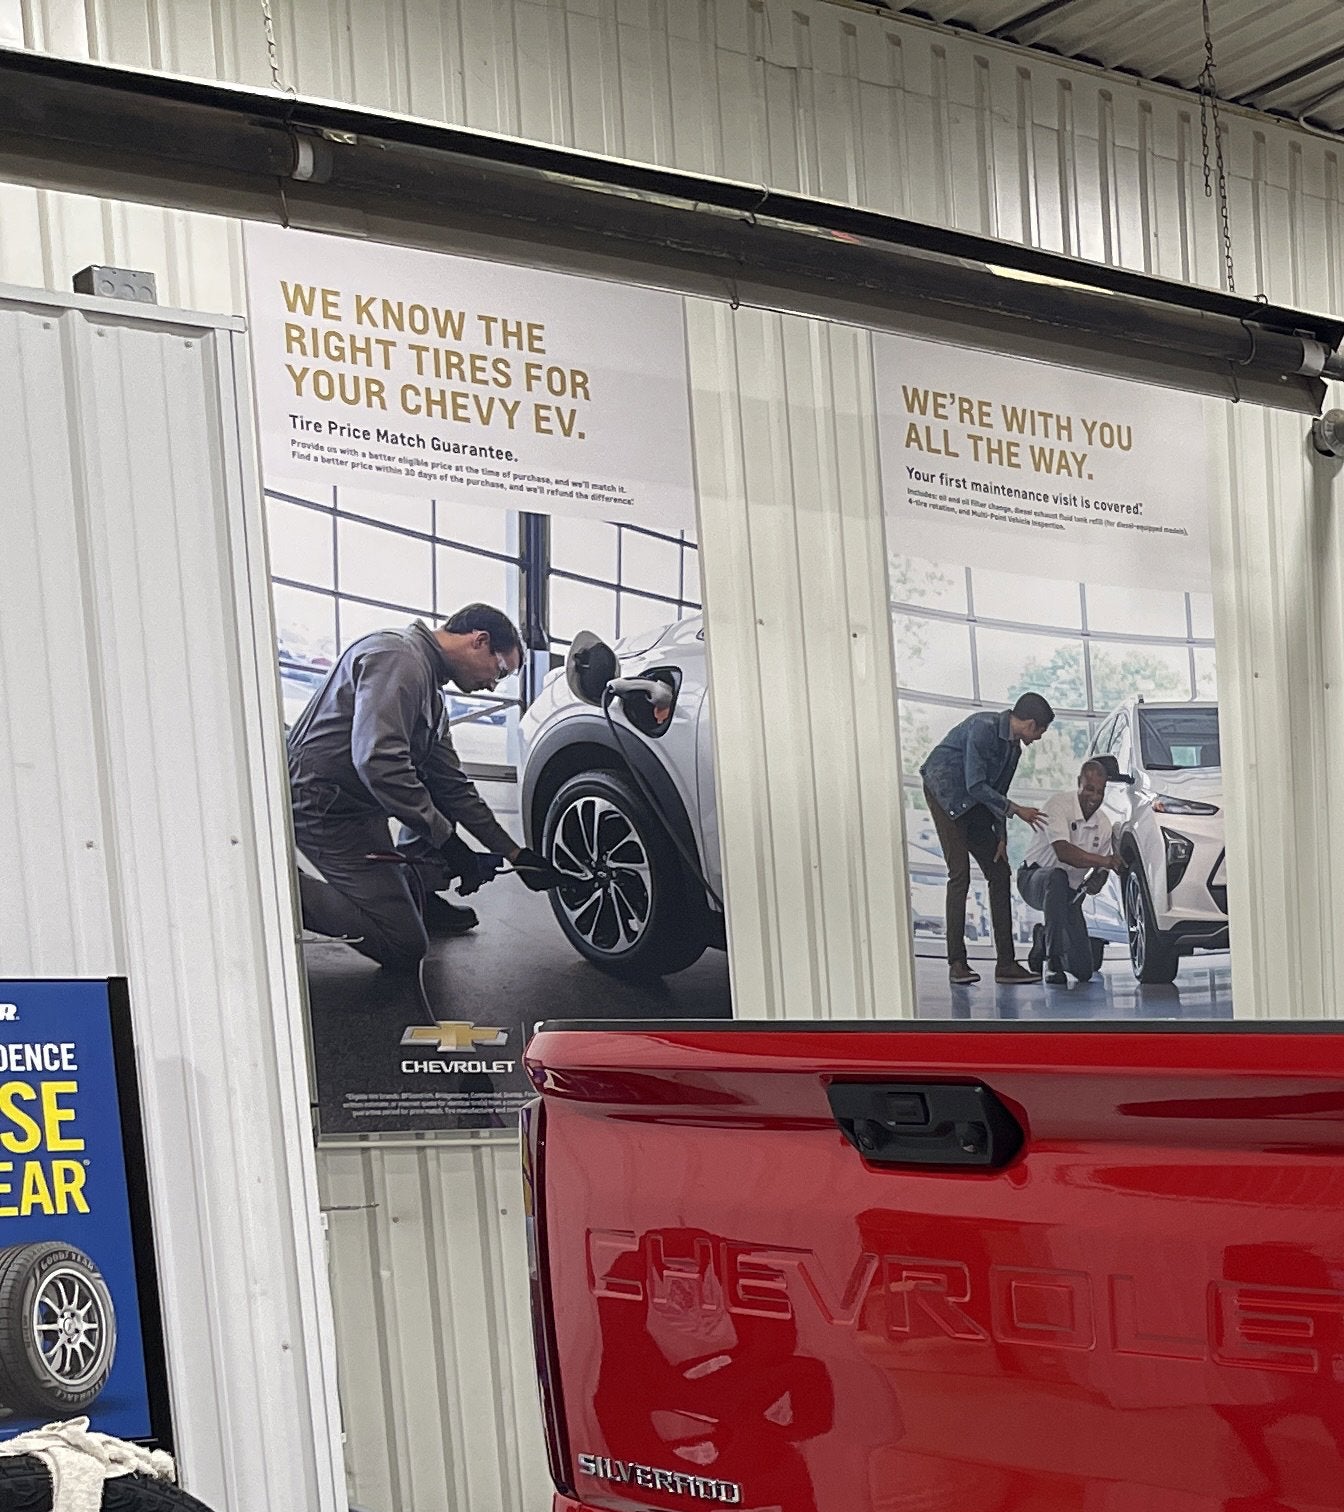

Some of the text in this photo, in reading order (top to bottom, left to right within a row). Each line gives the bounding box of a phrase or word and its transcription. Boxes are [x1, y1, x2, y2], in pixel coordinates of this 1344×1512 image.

[280, 280, 546, 355] WE KNOW THE
[285, 322, 591, 401] RIGHT TIRES FOR
[285, 364, 586, 440] YOUR CHEVY EV.
[902, 385, 1132, 452] WE'RE WITH YOU
[289, 414, 518, 463] Tire Price Match Guarantee.
[904, 422, 1094, 481] ALL THE WAY.
[291, 439, 325, 452] Provide
[340, 448, 359, 458] with
[368, 451, 396, 462] better
[398, 456, 429, 468] eligible
[431, 461, 453, 471] price
[455, 465, 464, 473] at
[466, 466, 479, 475] the
[481, 468, 500, 478] time
[502, 471, 511, 479] of
[513, 472, 553, 486] purchase,
[555, 478, 570, 487] and
[591, 483, 617, 493] match
[291, 451, 311, 462] Find
[321, 455, 349, 467] better
[351, 461, 374, 472] price
[375, 465, 403, 476] within
[405, 468, 416, 477] 30
[418, 470, 438, 481] days
[450, 474, 464, 484] the
[466, 478, 507, 491] purchase,
[509, 484, 524, 492] and
[547, 488, 574, 498] refund
[576, 491, 589, 500] the
[906, 465, 936, 484] Your
[939, 473, 967, 490] first
[971, 481, 1049, 503] maintenance
[1052, 493, 1078, 508] visit
[1081, 495, 1091, 509] is
[401, 1060, 516, 1074] CHEVROLET
[577, 1452, 743, 1504] SILVERADO
